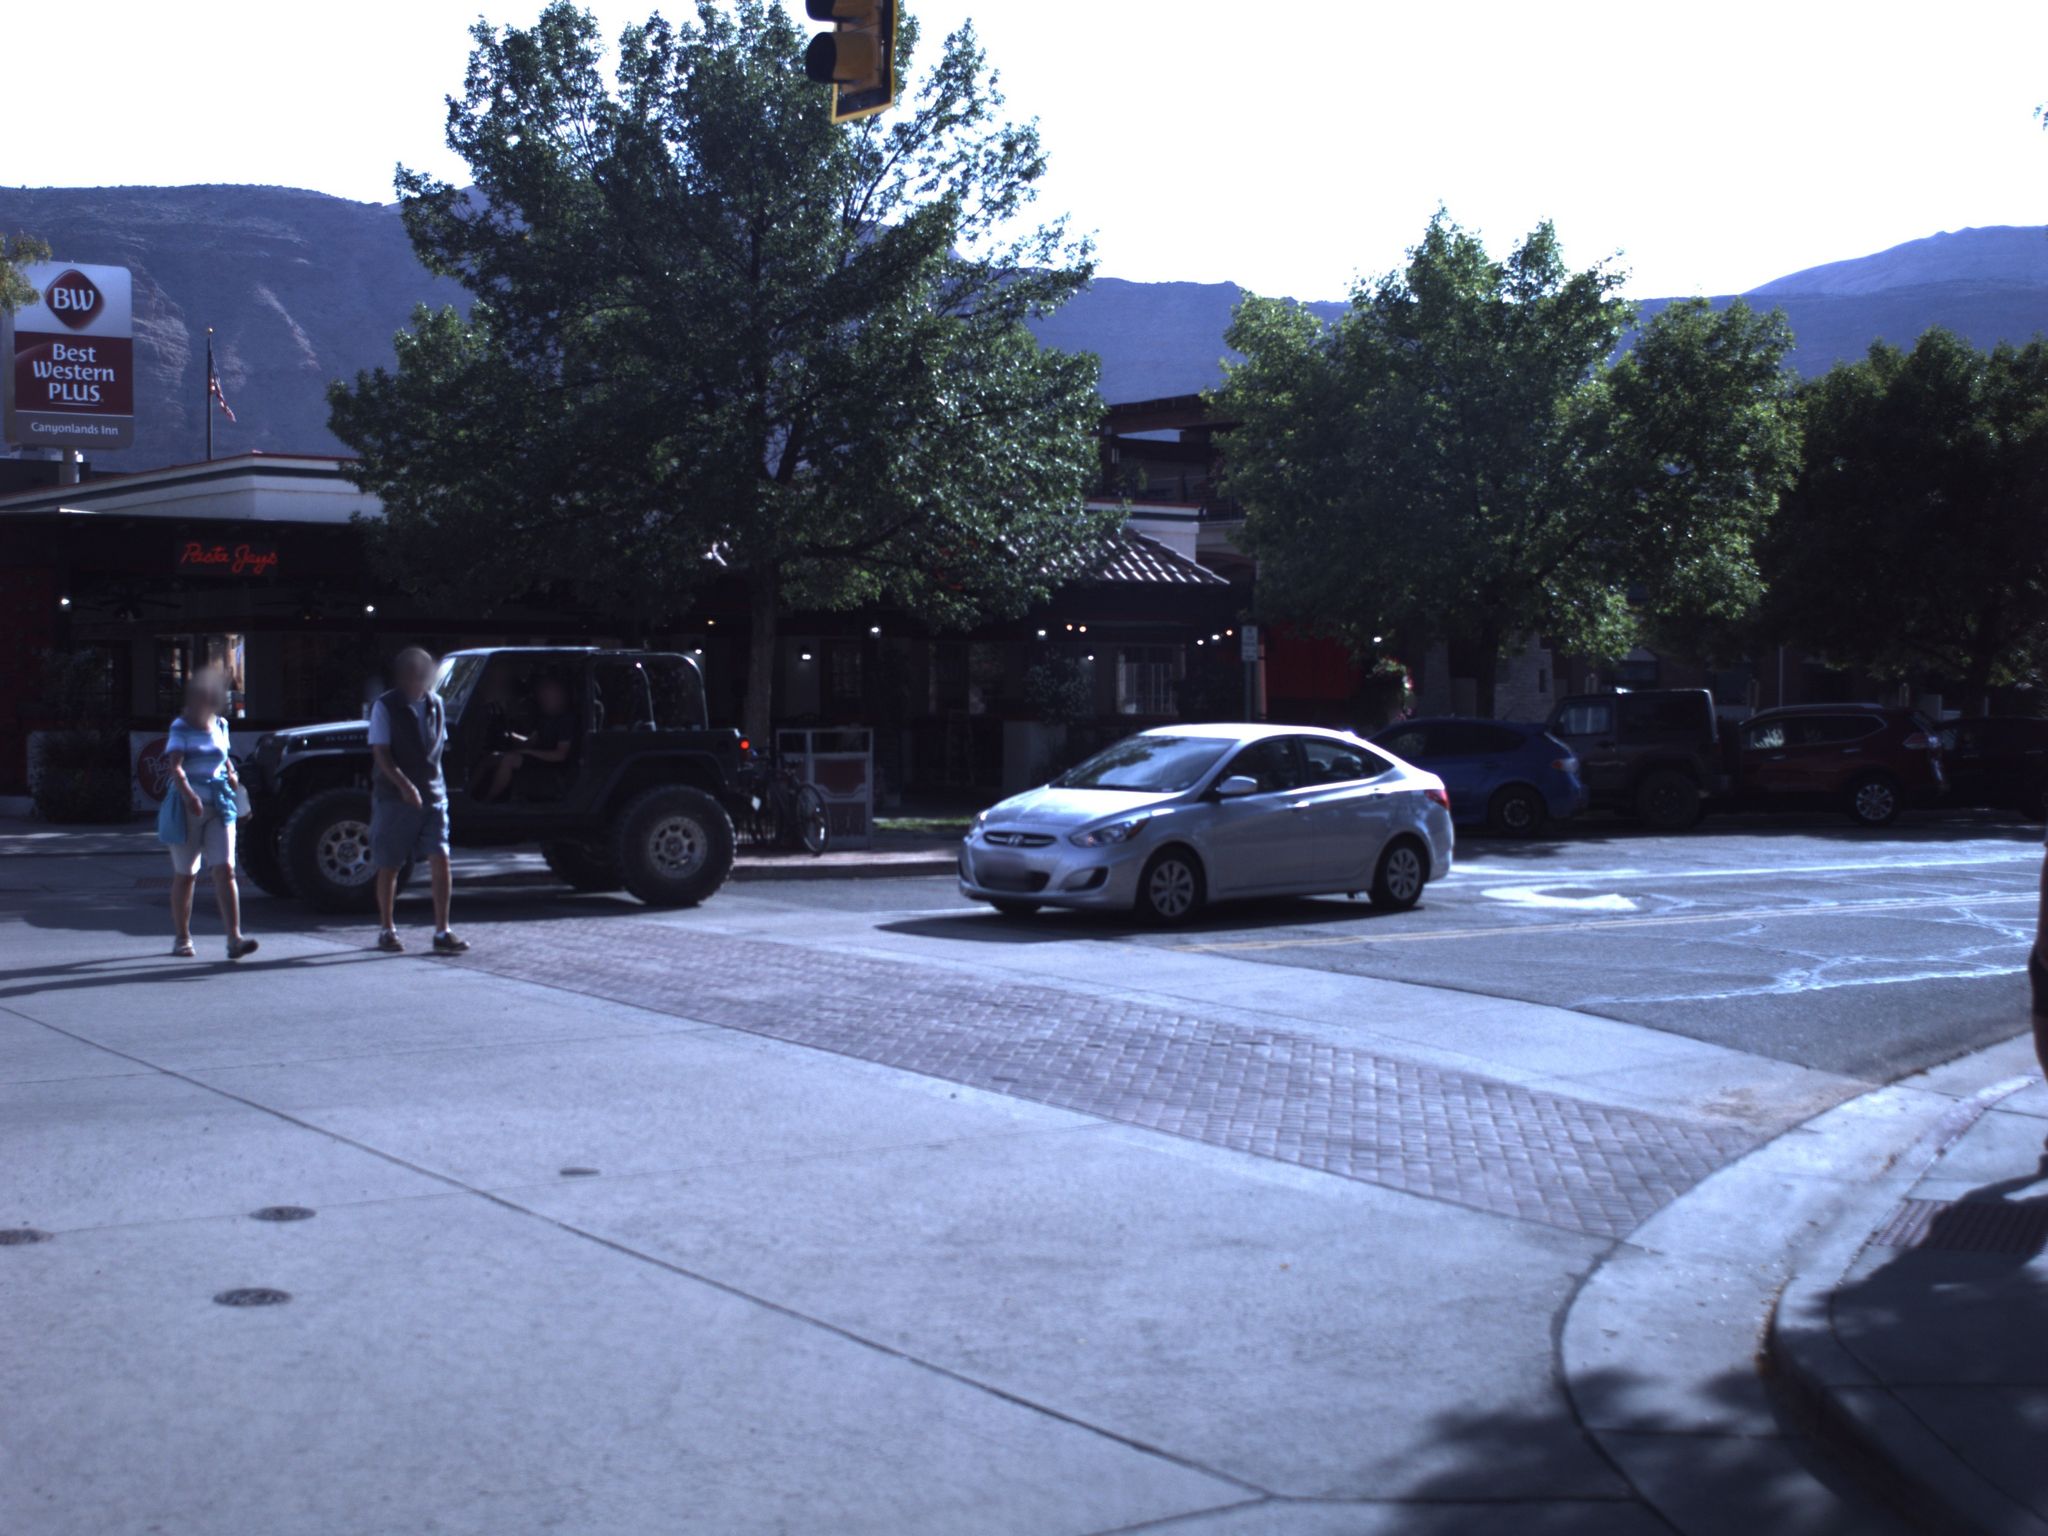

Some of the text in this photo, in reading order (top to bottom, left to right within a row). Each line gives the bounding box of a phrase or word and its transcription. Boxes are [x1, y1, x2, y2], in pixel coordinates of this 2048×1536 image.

[53, 287, 95, 311] BW
[53, 343, 96, 363] Best
[32, 360, 115, 382] Western
[48, 382, 101, 402] PLUS
[31, 421, 119, 436] Canyonlands Inn
[181, 544, 229, 564] Pasta
